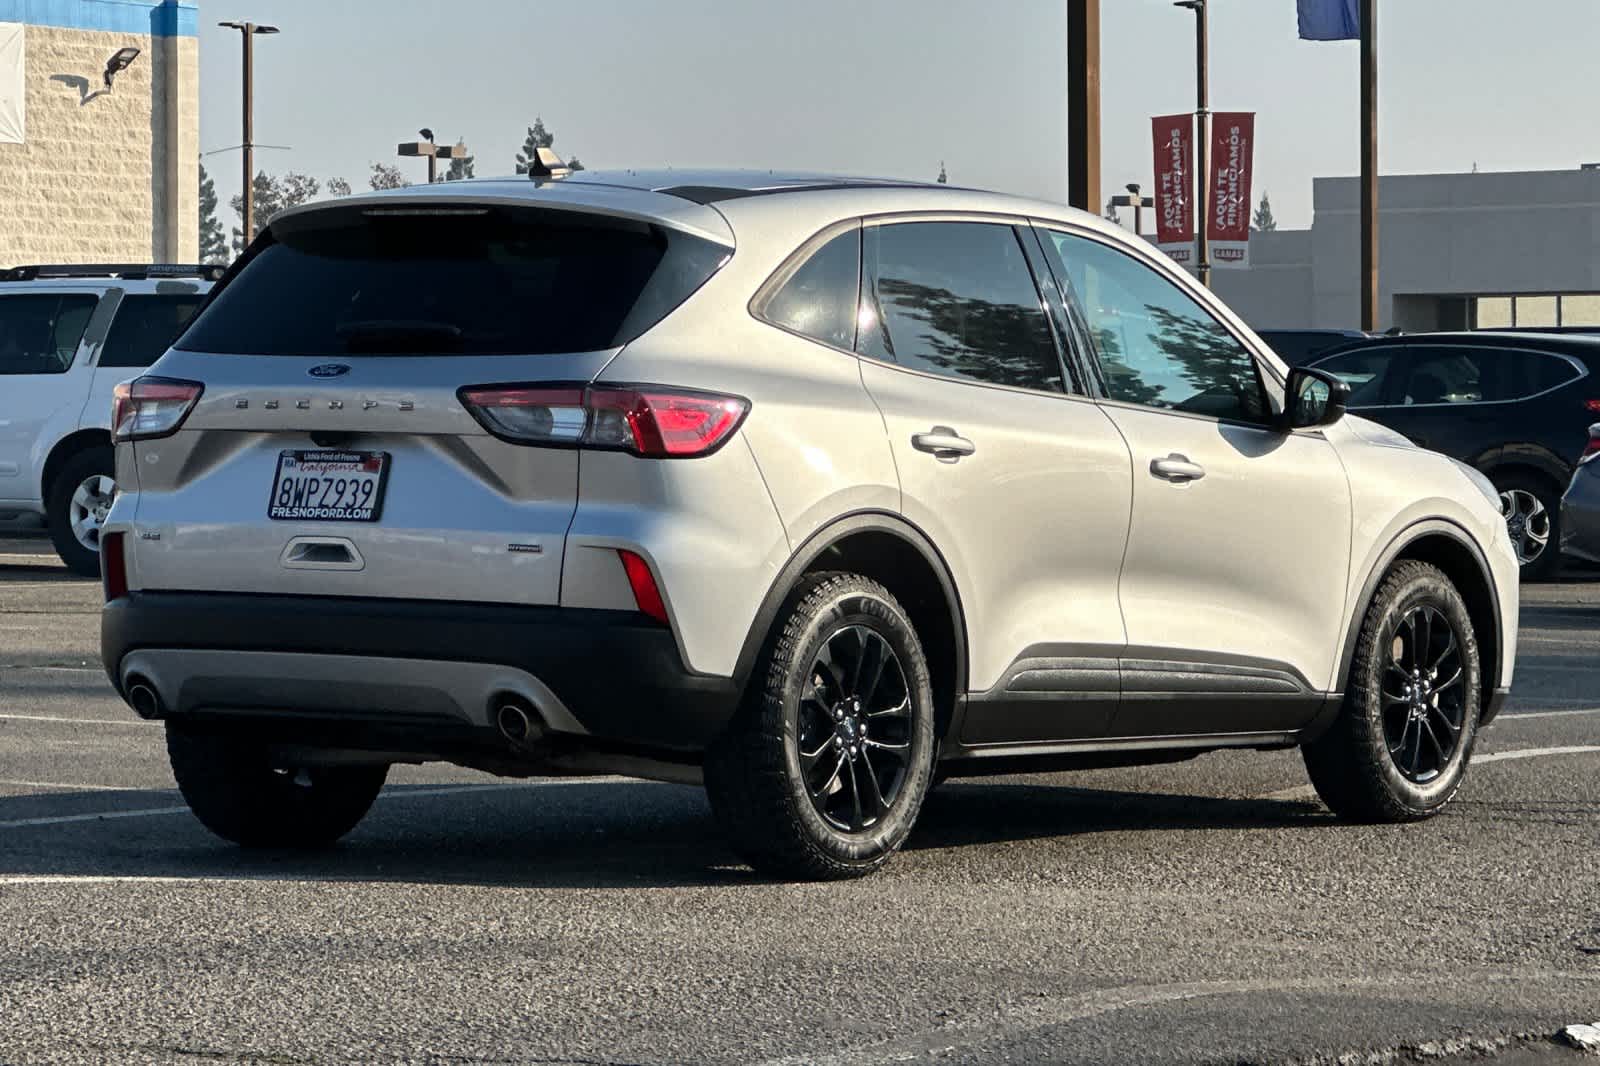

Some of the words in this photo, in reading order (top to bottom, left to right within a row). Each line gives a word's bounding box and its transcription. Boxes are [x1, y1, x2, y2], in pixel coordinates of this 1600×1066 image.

[1161, 172, 1172, 191] TE
[1170, 128, 1184, 229] FINANCIAMOS
[1217, 168, 1229, 189] TE
[1227, 125, 1240, 226] FINANCIAMOS
[1215, 190, 1227, 226] AQUÍ
[279, 477, 374, 509] 8WPZ939
[271, 507, 372, 519] FRESNOFORD.COM
